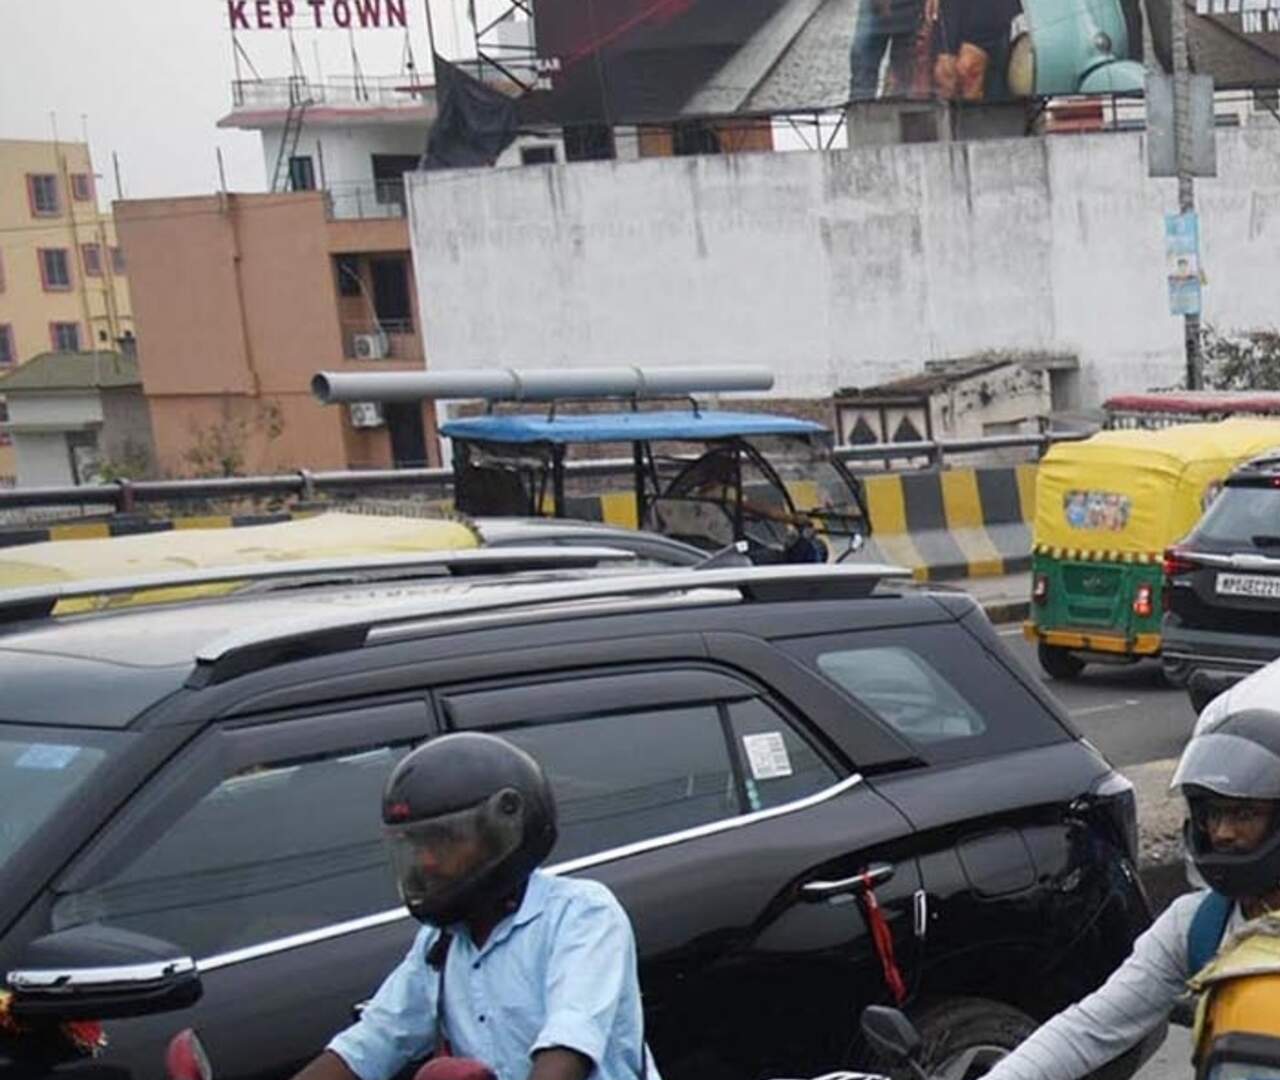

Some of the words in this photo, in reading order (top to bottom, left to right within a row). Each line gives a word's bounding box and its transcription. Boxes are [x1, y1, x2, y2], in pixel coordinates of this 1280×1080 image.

[229, 0, 295, 29] KEP
[304, 0, 408, 28] TOWN
[1241, 11, 1263, 33] IN
